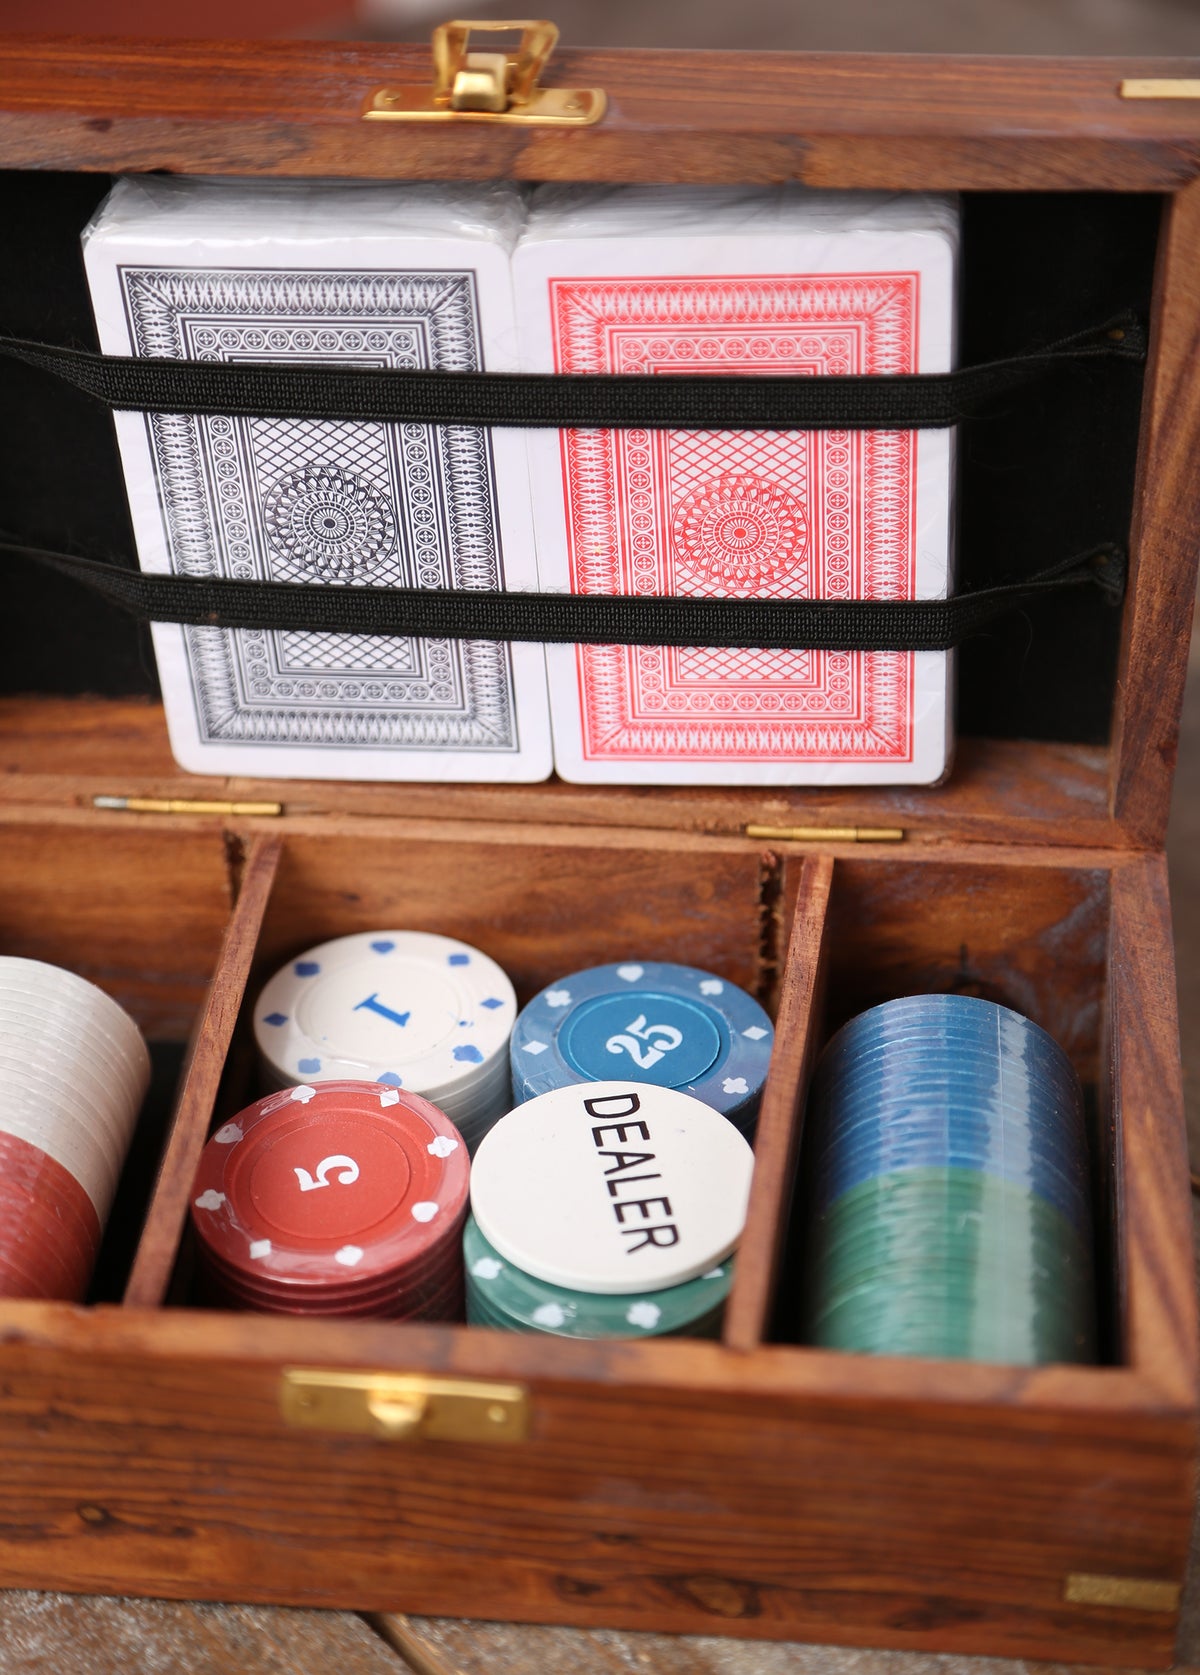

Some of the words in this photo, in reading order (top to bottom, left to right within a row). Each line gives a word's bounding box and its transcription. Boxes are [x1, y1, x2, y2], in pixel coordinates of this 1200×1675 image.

[353, 993, 411, 1028] 1
[605, 1014, 684, 1069] 25
[293, 1154, 360, 1192] 5
[583, 1092, 680, 1256] DEALER
